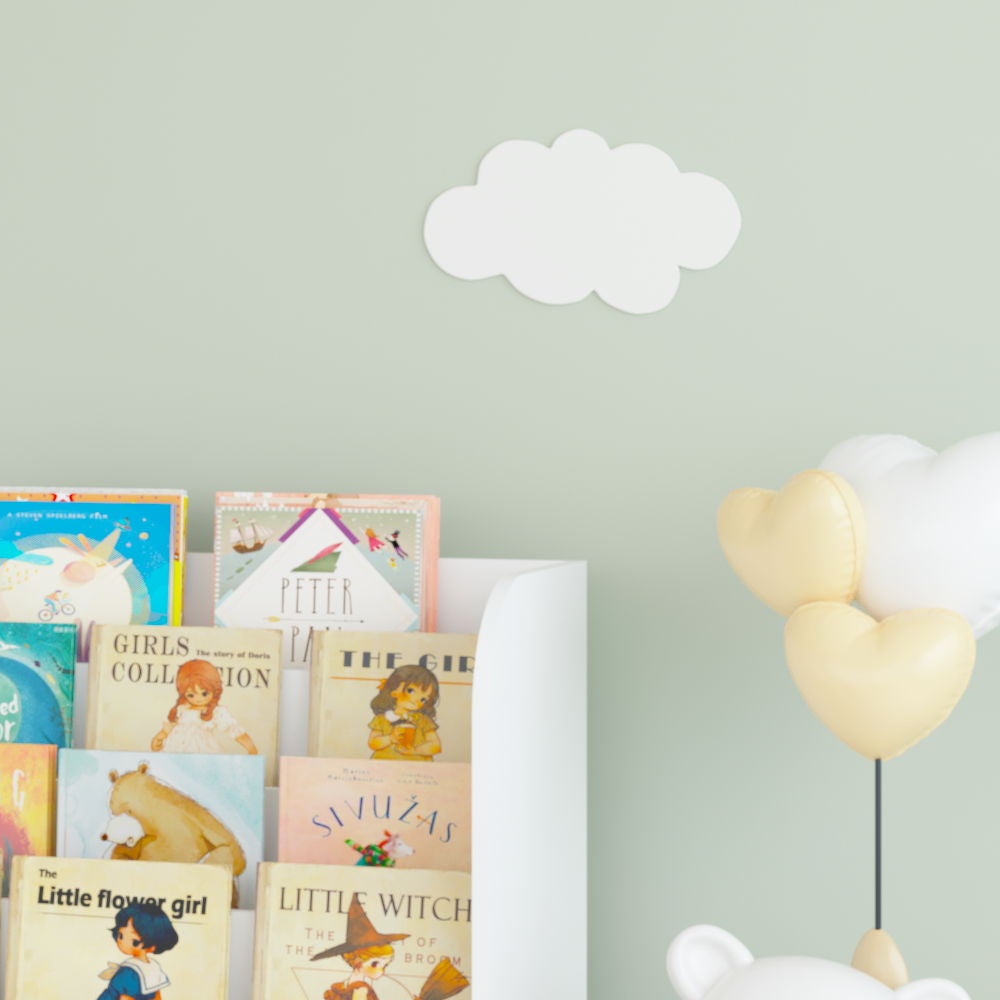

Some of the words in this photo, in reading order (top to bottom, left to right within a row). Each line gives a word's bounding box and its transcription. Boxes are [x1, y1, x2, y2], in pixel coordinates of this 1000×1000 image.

[280, 577, 353, 615] PETER
[113, 633, 190, 657] GIRLS
[196, 649, 210, 657] The
[340, 649, 403, 670] THE
[111, 661, 271, 689] COLLION
[38, 869, 58, 880] The
[38, 885, 92, 907] Little
[171, 895, 207, 919] girl
[378, 893, 471, 922] WITCH
[304, 927, 335, 941] THE
[417, 936, 437, 948] OF
